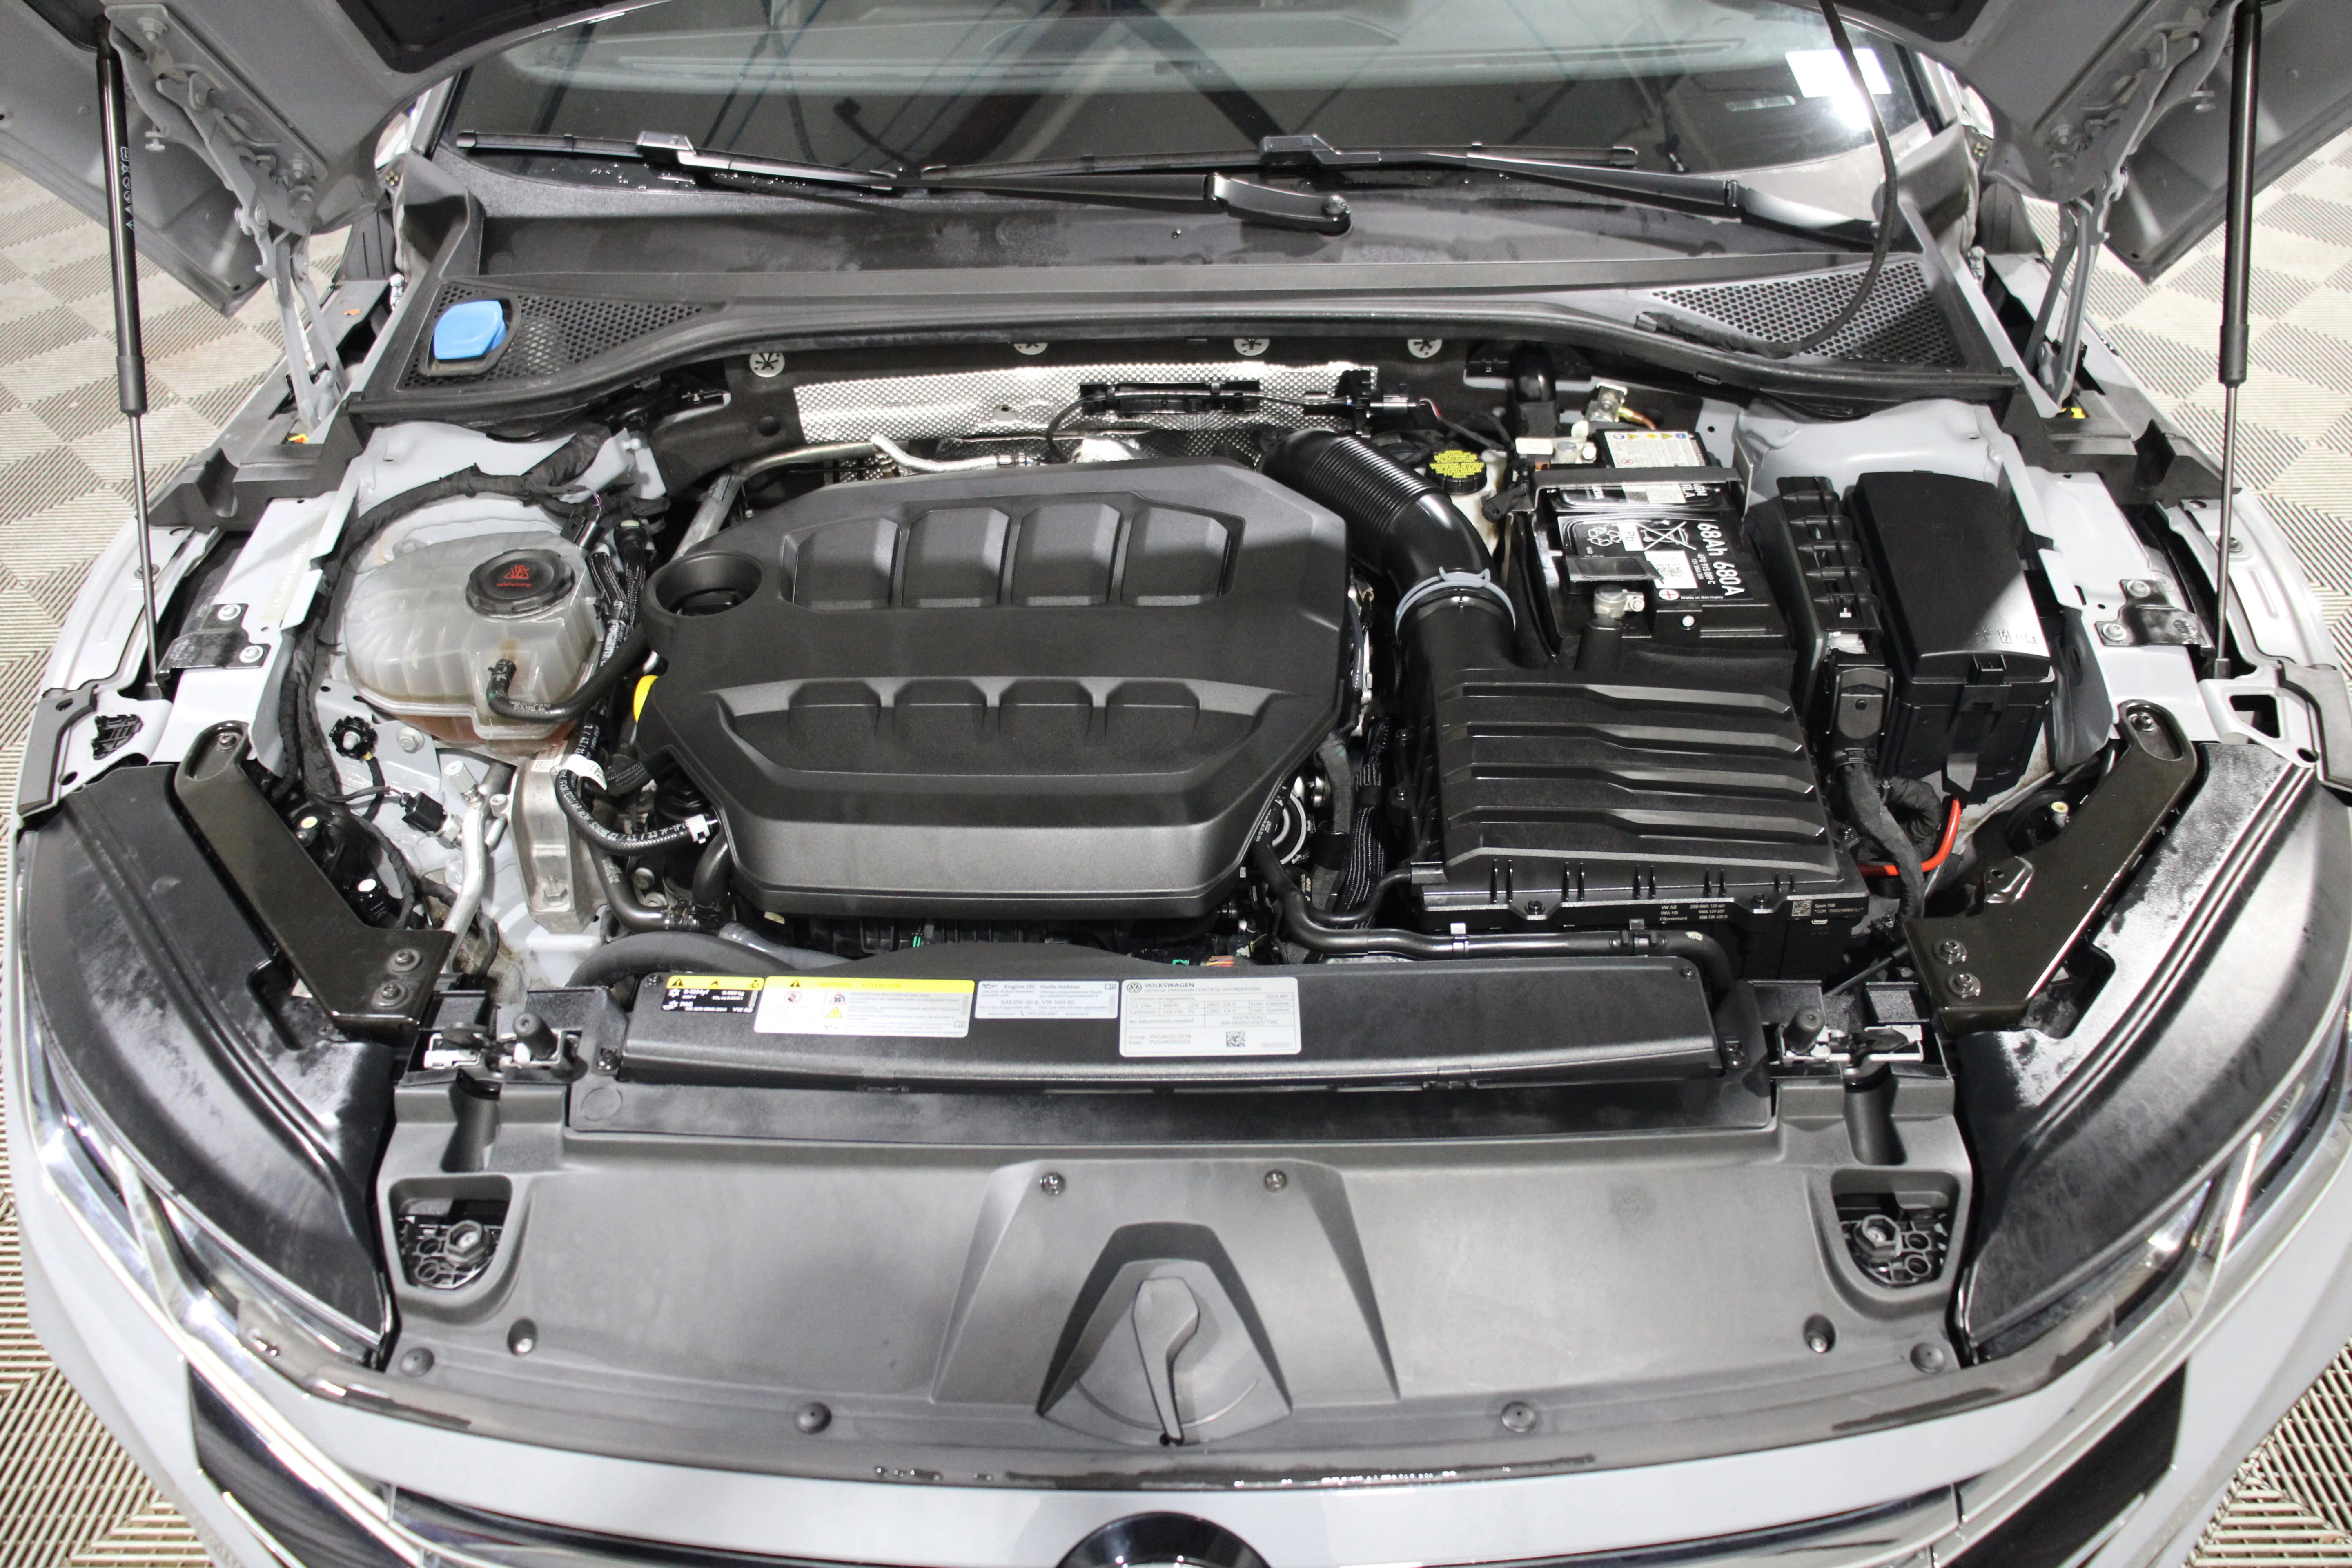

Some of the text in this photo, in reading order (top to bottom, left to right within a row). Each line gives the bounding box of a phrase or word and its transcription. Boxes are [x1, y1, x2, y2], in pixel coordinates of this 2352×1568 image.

[1679, 484, 1696, 498] RLA
[1623, 531, 1635, 542] Pb
[1697, 523, 1745, 596] 68Ah 680A
[1701, 563, 1711, 572] 915
[1704, 572, 1714, 580] 089
